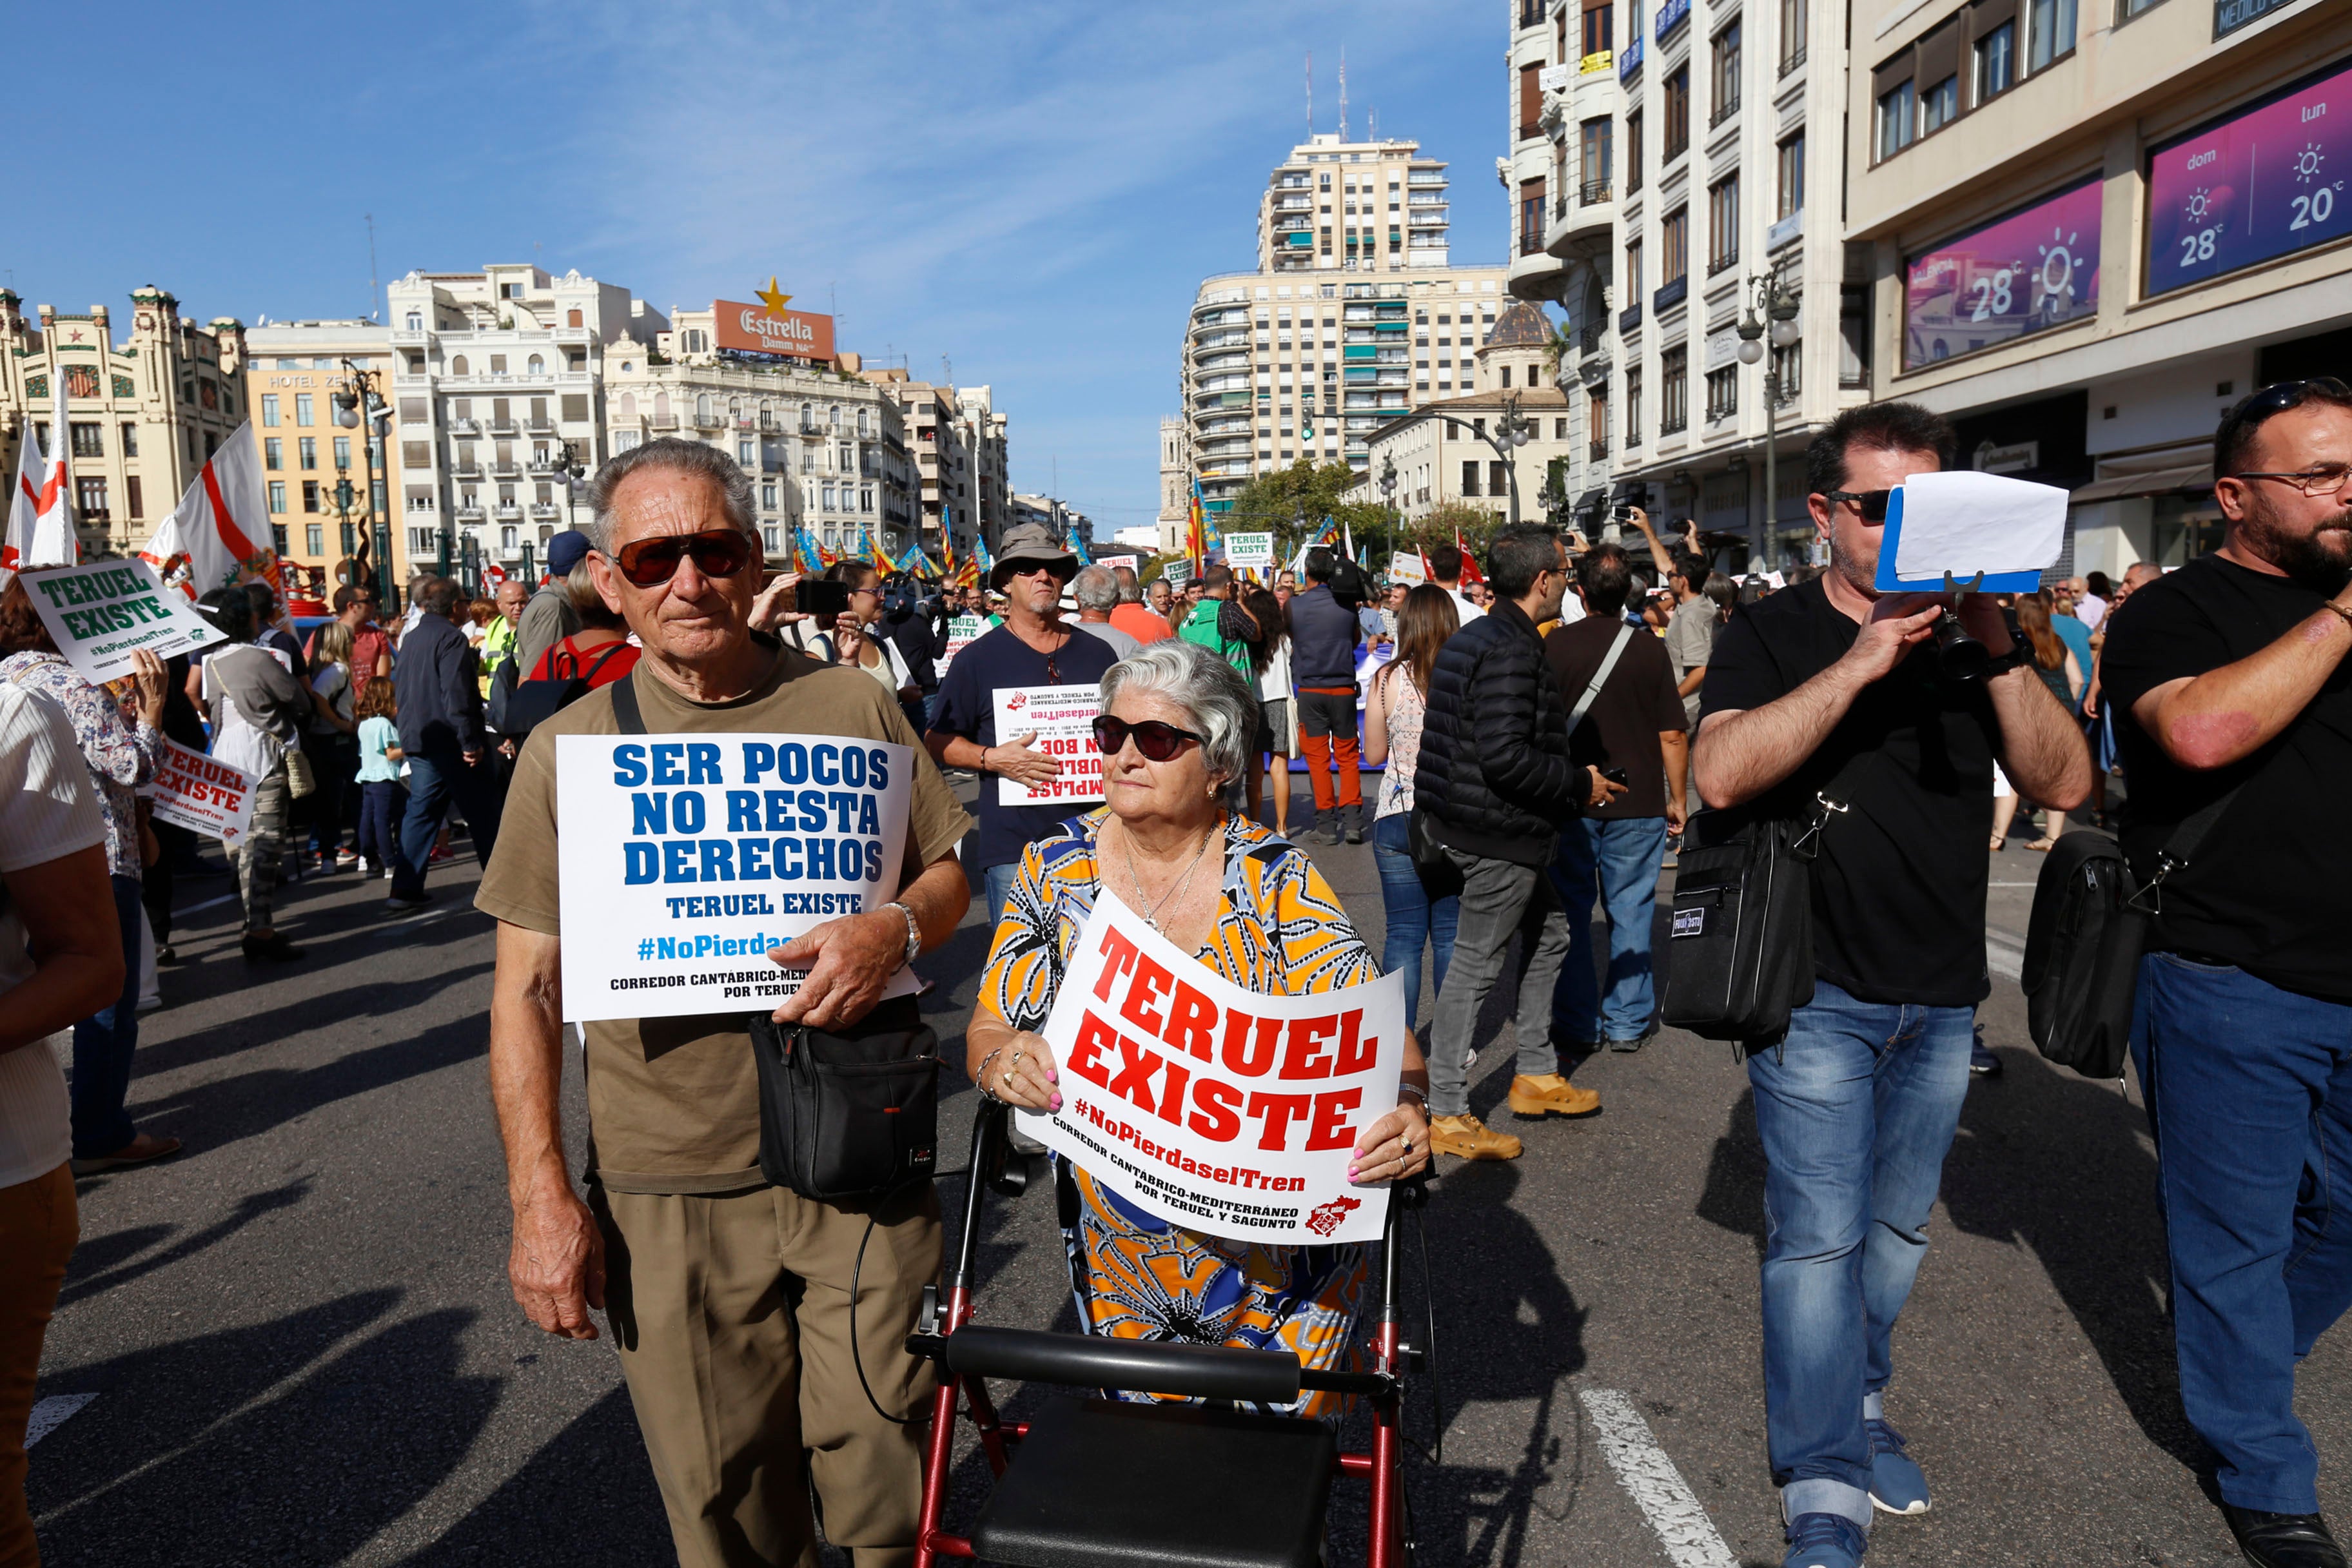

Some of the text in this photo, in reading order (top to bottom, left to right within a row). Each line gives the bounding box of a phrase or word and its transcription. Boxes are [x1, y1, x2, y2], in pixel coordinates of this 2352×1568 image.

[2301, 103, 2326, 123] lun
[2187, 150, 2217, 170] dom
[740, 309, 814, 341] Estrella
[761, 335, 794, 350] Damm
[270, 376, 318, 387] HOTEL
[1230, 535, 1268, 544] TERUEL
[1232, 545, 1267, 554] EXISTE
[1101, 558, 1133, 567] TERUEL
[1168, 560, 1193, 573] TERUEL
[1170, 569, 1192, 580] EXISTE
[37, 567, 152, 609] TERUEL
[60, 596, 173, 641] EXISTE
[90, 627, 176, 656] #NoPierdaselTren
[948, 628, 976, 637] XISTE
[1031, 709, 1100, 720] ierdaselTren
[1041, 738, 1102, 756] BOE N
[164, 744, 248, 794] ERUEL
[613, 742, 889, 790] SER POCOS
[152, 767, 241, 813] EXISTE
[631, 790, 881, 836] NO RESTA
[623, 837, 883, 885] DERECHOS
[666, 893, 862, 918] TERUEL EXISTE
[611, 975, 685, 990] CORREDOR
[724, 984, 750, 998] POR
[1092, 924, 1378, 1080] TERUEL
[1066, 1007, 1362, 1152] EXISTE
[1075, 1098, 1305, 1192] #NoPierdaselTren
[1052, 1116, 1298, 1218] CORREDOR CANTÁBRICO-MEDITERRÁNEO
[1135, 1181, 1297, 1230] POR TERUEL Y SAGUNTO
